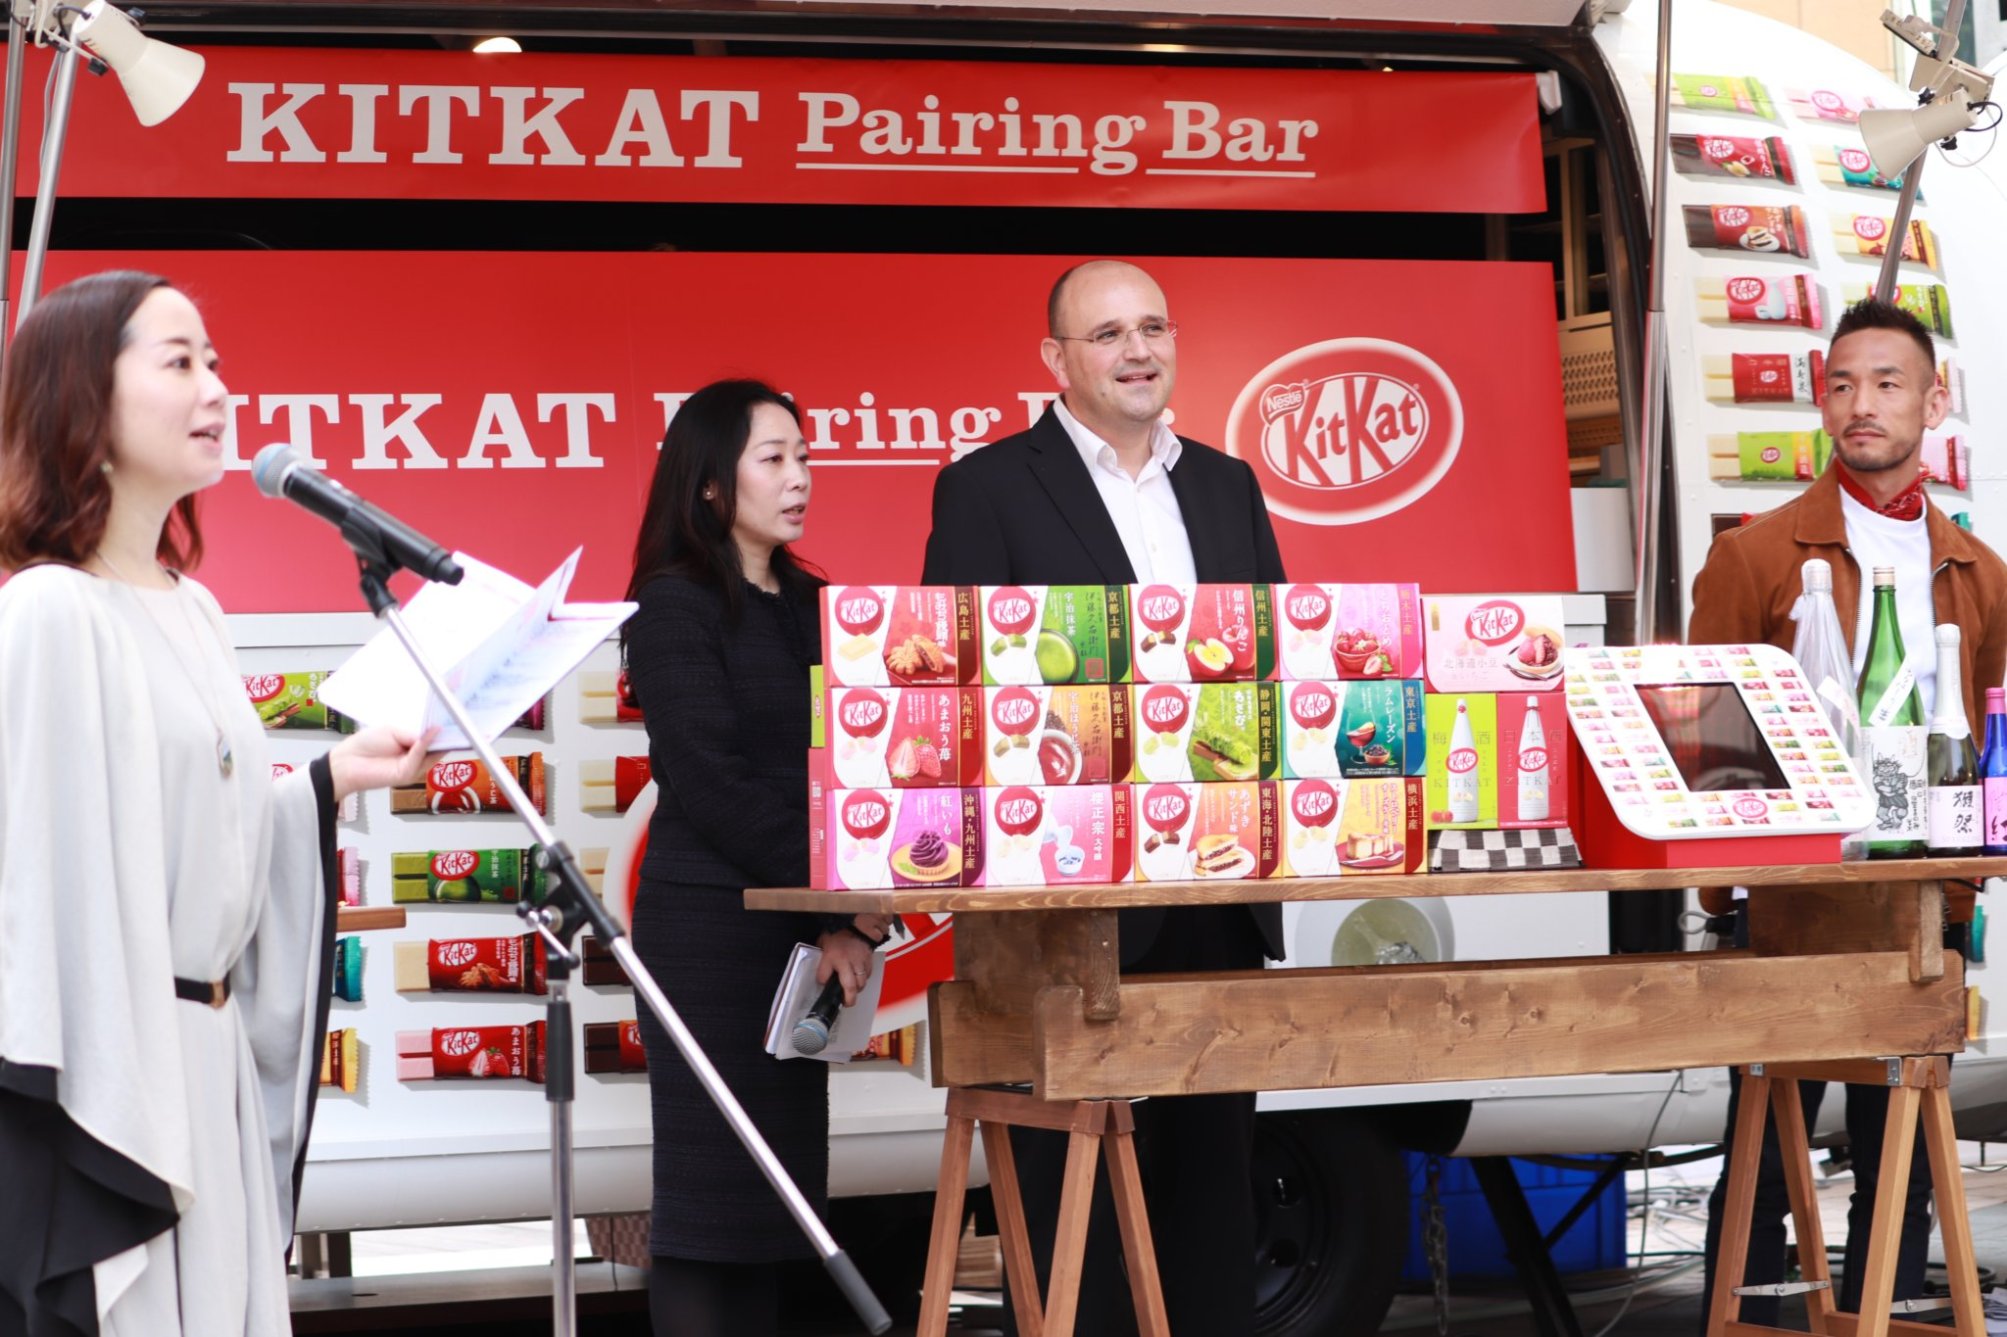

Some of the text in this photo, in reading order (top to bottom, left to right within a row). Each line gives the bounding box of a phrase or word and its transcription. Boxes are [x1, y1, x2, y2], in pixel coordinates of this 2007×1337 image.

[226, 82, 1319, 176] KITKAT Pairing Bar
[222, 392, 616, 470] ITKAT
[1284, 376, 1418, 486] KitKat
[845, 598, 877, 622] KitKat
[958, 592, 970, 640] 広島土産
[998, 598, 1029, 622] KitKat
[1064, 592, 1075, 637] 宇治抹茶
[1108, 591, 1120, 639] 京都土産
[1148, 596, 1180, 620] KitKat
[1255, 589, 1268, 638] 信州土産
[1294, 595, 1326, 619] KitKat
[1479, 609, 1514, 637] KitKat
[246, 675, 277, 697] KitKat
[850, 700, 881, 726] KitKat
[961, 693, 973, 740] 九州土産
[1003, 699, 1033, 725] KitKat
[1113, 690, 1125, 739] 京都土産
[1151, 696, 1183, 721] KitKat
[1300, 696, 1331, 720] KitKat
[1385, 686, 1400, 743] ラムレーズン
[1406, 686, 1417, 733] 東京土産
[938, 694, 951, 762] あまおう苺
[438, 763, 470, 787] KitKat
[853, 802, 883, 827] KitKat
[940, 795, 952, 836] 紅いも
[1006, 798, 1037, 824] KitKat
[1114, 790, 1126, 838] 関西土産
[1152, 795, 1184, 820] KitKat
[1228, 789, 1238, 833] サンド味
[1240, 789, 1251, 828] あずき
[1301, 792, 1332, 816] KitKat
[1407, 783, 1418, 830] 横浜土産
[964, 794, 976, 869] 沖縄・九州土産
[442, 852, 472, 876] KitKat
[443, 943, 475, 966] KitKat
[447, 1032, 478, 1055] KitKat
